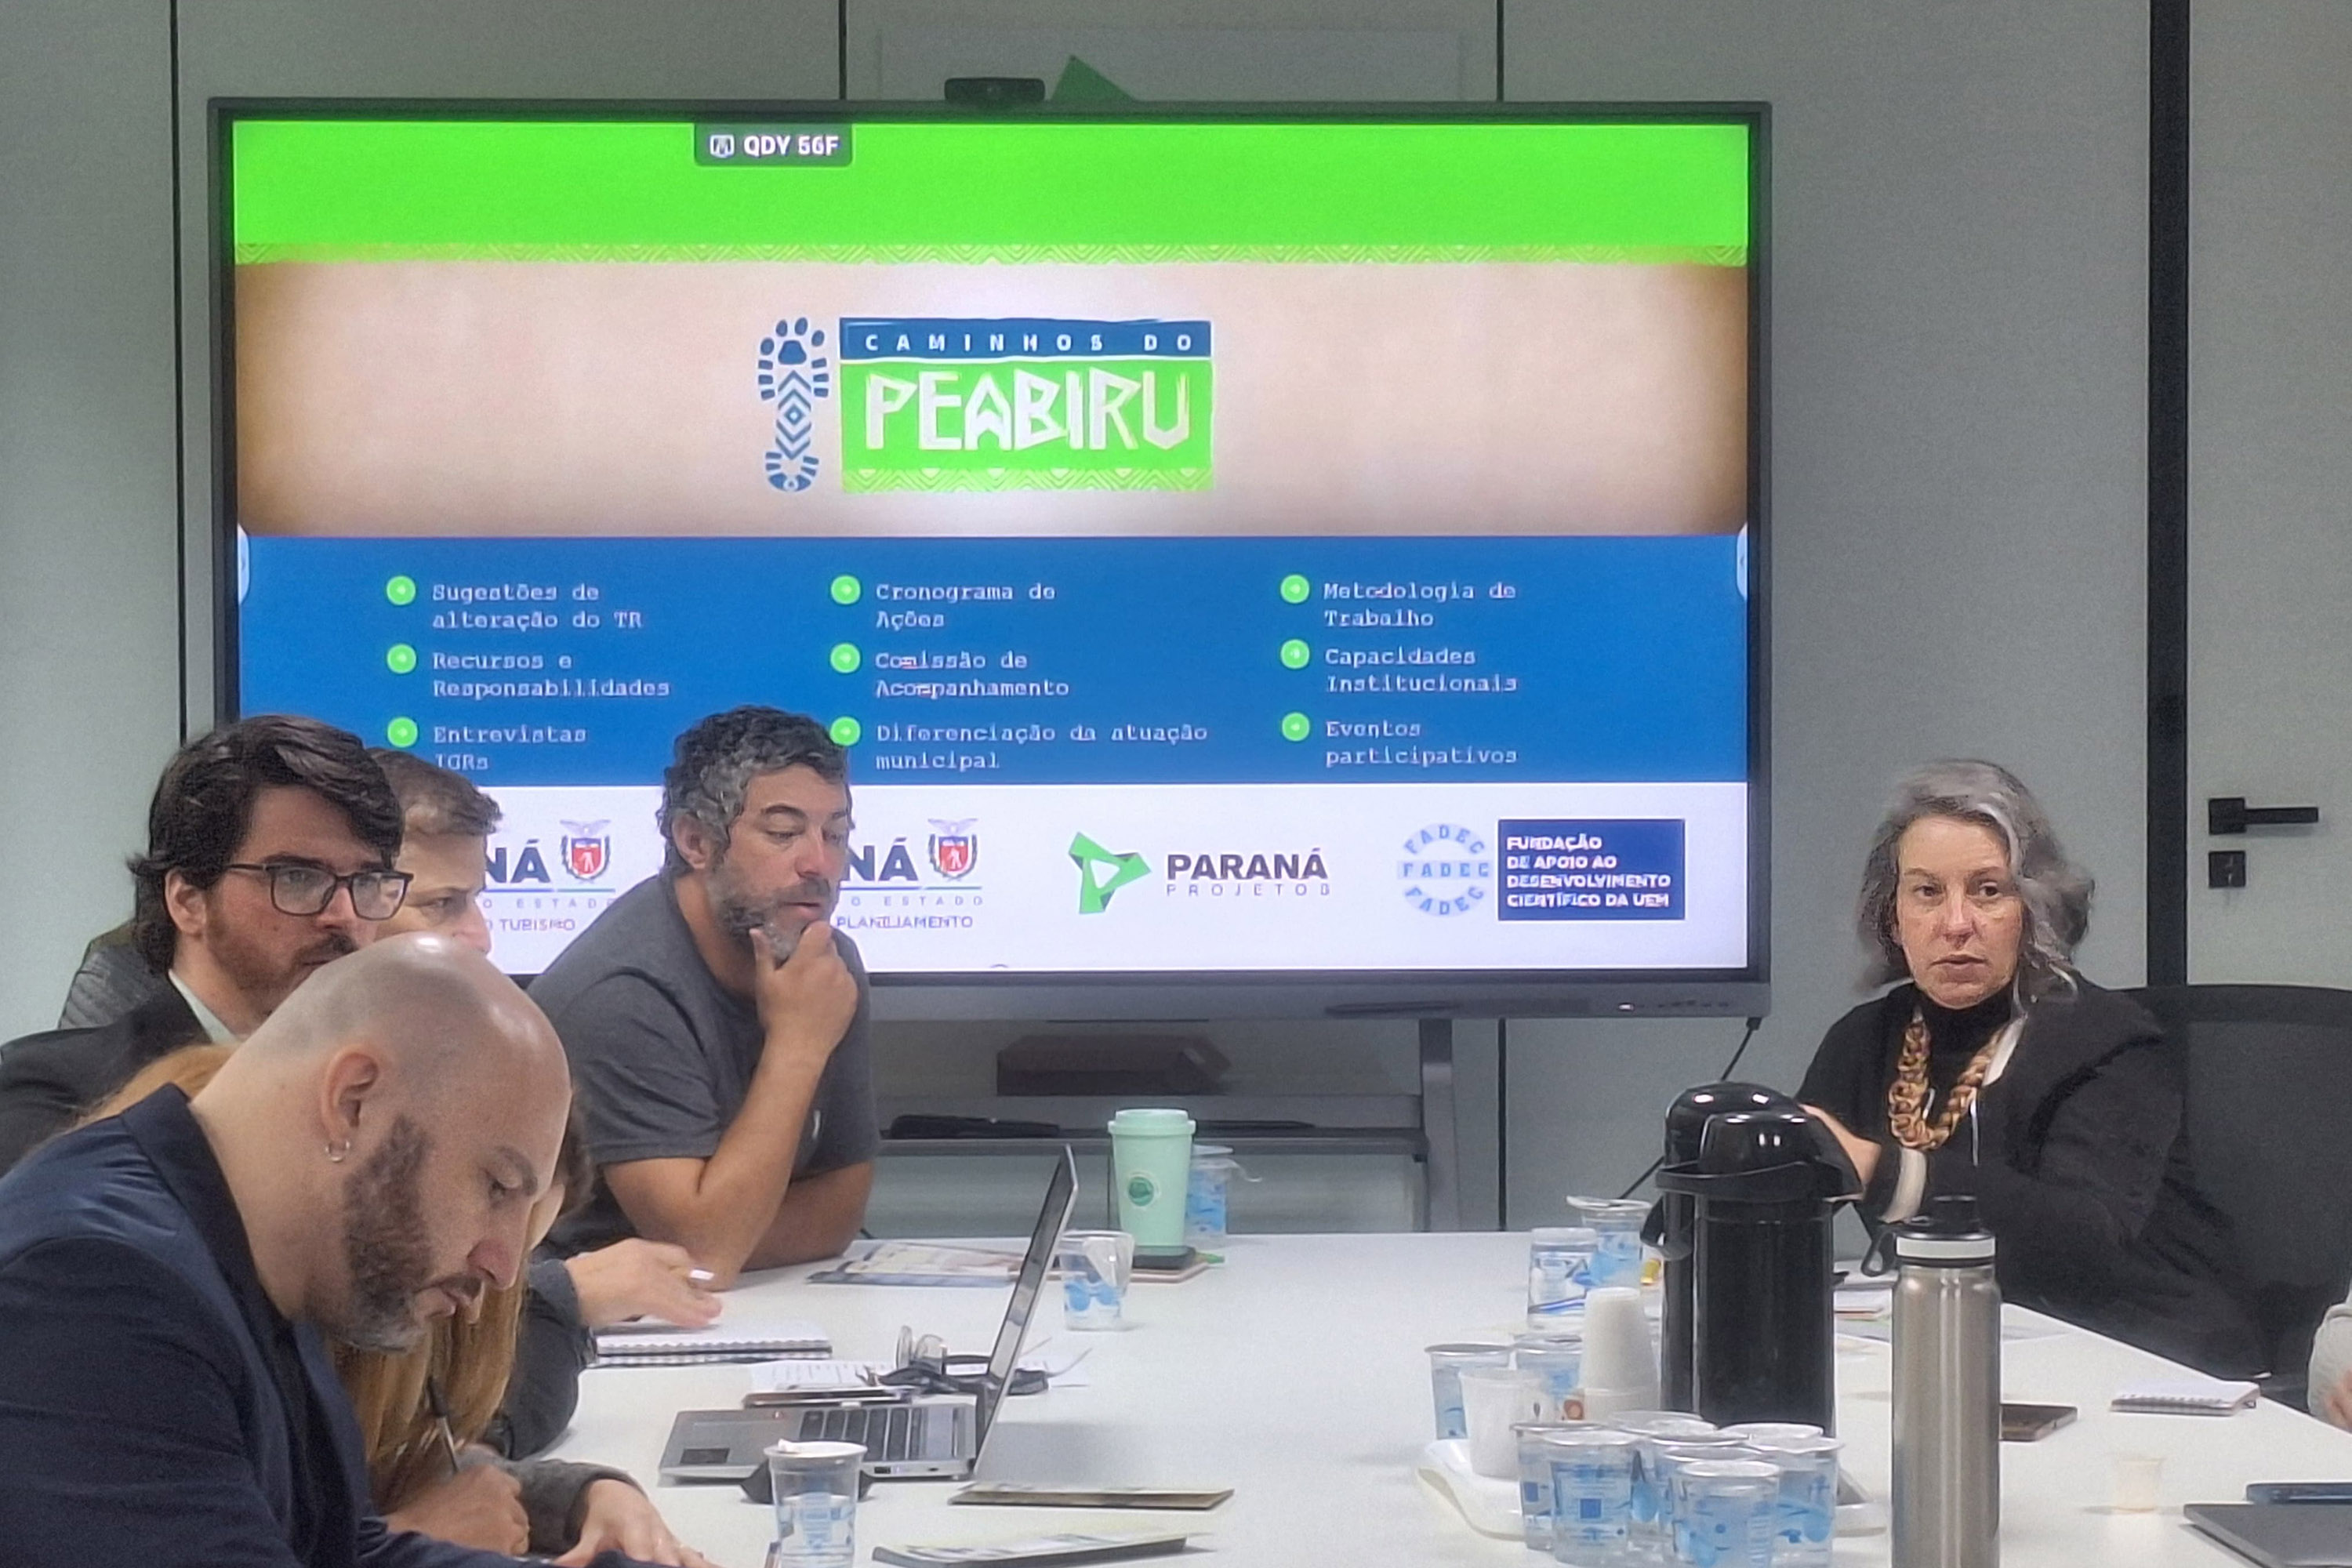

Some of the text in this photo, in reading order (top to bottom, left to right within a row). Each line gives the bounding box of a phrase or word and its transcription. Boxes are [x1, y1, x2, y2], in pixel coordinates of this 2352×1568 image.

[744, 135, 790, 157] QDY
[866, 334, 1192, 351] CAMINHOS DO
[866, 367, 1190, 451] PEABIRU
[432, 583, 599, 604] Sugestões de
[876, 583, 1055, 603] Cronograma de
[1323, 582, 1515, 602] Metodologia de
[432, 610, 641, 632] alteração do TR
[876, 610, 945, 631] Ações
[1324, 608, 1434, 627] Trabalho
[433, 652, 572, 670] Recursos e
[875, 650, 1028, 670] Comissão de
[1325, 647, 1475, 669] Capacidades
[434, 678, 670, 701] Responsabilidades
[876, 679, 1069, 700] Acompanhamento
[1328, 673, 1517, 692] Institucionais
[434, 724, 586, 743] Entrevistas
[877, 724, 1207, 746] Diferenciação da atuação
[1326, 720, 1421, 739] Eventos
[876, 751, 1000, 772] municipal
[1326, 746, 1517, 768] participativos
[1403, 824, 1486, 855] FADEC
[1506, 833, 1602, 851] FUNDAÇÃO
[1167, 848, 1328, 880] PARANÁ
[1403, 862, 1489, 877] FADEC
[1506, 855, 1617, 869] DE APOIO AO
[1167, 884, 1330, 896] PROJETOS
[1506, 874, 1671, 888] DESENVOLVIMENTO
[884, 895, 983, 906] ESTADO
[1506, 891, 1669, 908] CIENTÍFICO DA UEM
